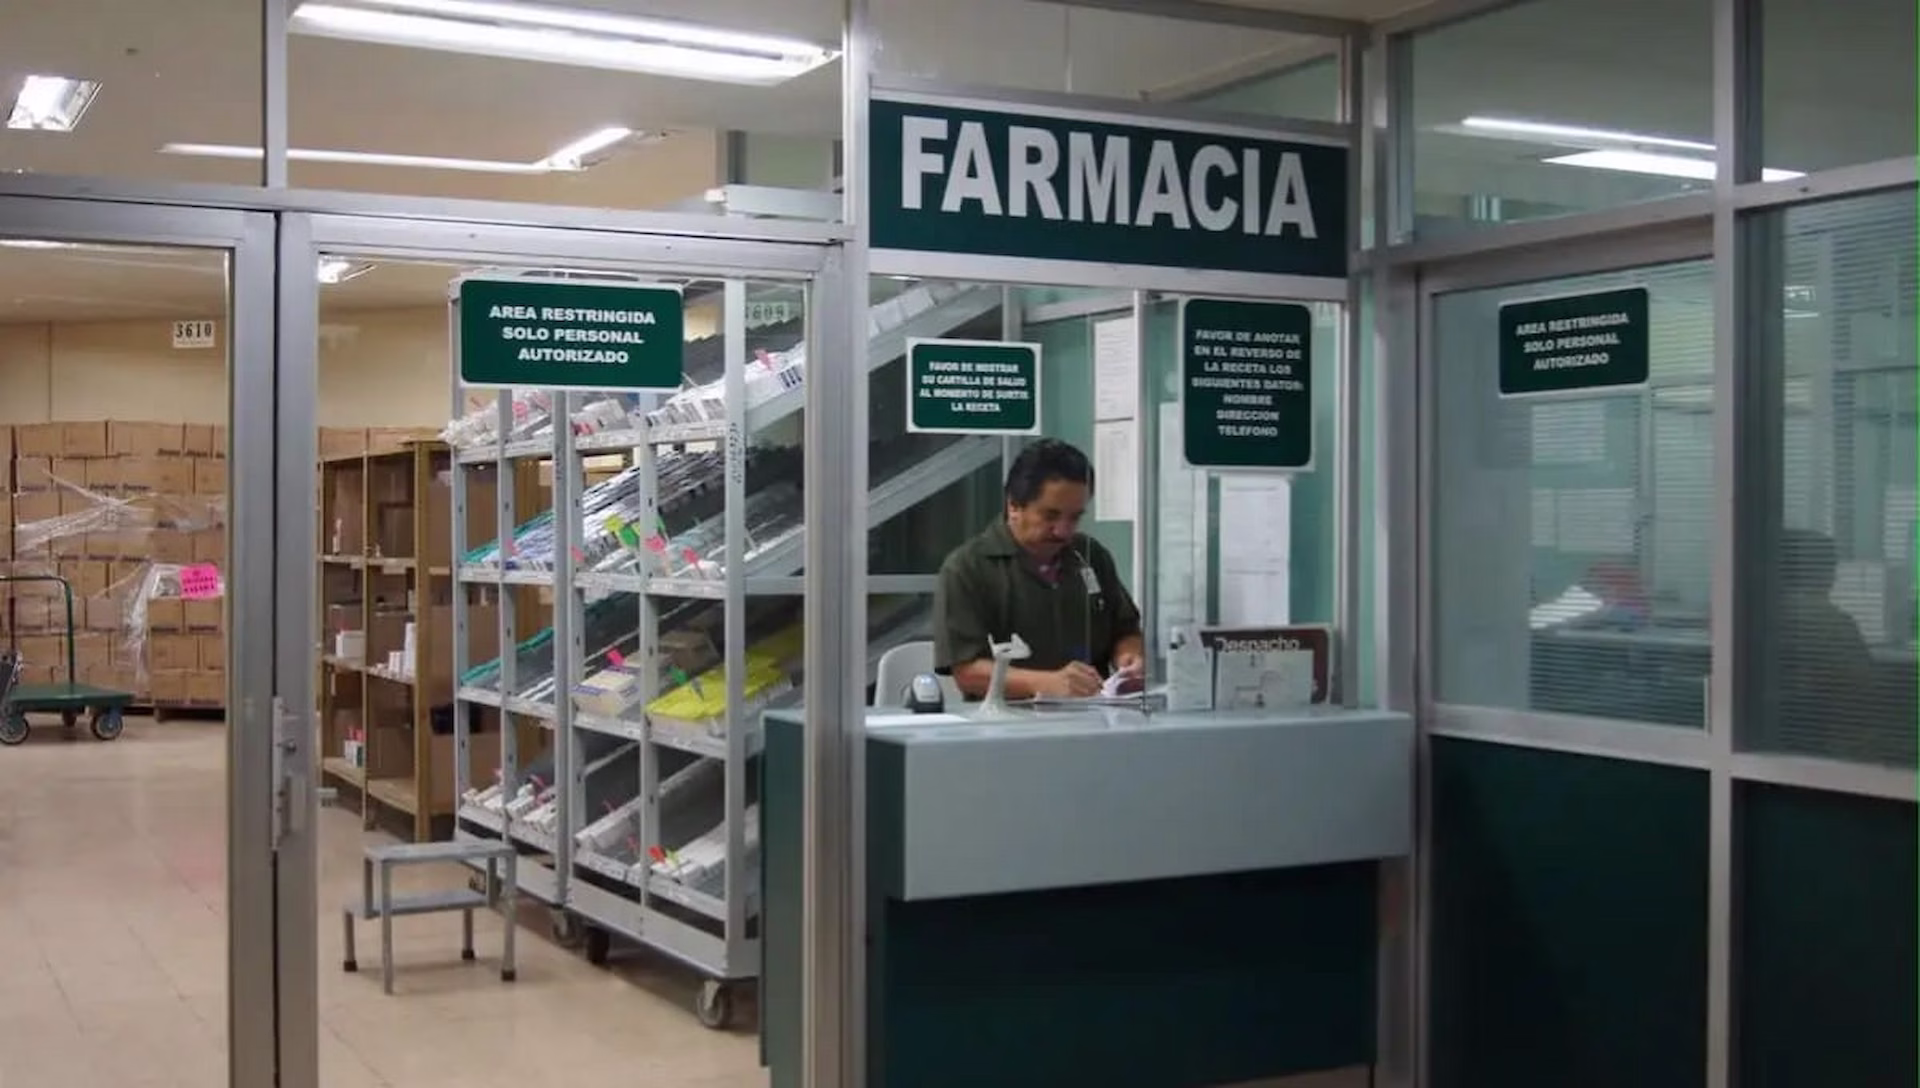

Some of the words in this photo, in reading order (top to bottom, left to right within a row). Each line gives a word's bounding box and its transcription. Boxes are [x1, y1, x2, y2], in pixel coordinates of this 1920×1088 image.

[902, 114, 1318, 239] FARMACIA
[489, 305, 537, 320] AREA
[541, 307, 656, 324] RESTRINGIDA
[175, 322, 212, 338] 3610
[1516, 322, 1547, 336] AREA
[1548, 312, 1629, 332] RESTRINGIDA
[502, 326, 550, 341] SOLO
[554, 328, 645, 344] PERSONAL
[1196, 329, 1233, 341] FAVOR
[1235, 331, 1251, 342] DE
[1253, 332, 1301, 344] ANOTAR
[1523, 339, 1555, 353] SOLO
[1556, 332, 1621, 349] PERSONAL
[517, 347, 630, 364] AUTORIZADO
[1194, 344, 1211, 356] EN
[1213, 345, 1228, 357] EL
[1229, 346, 1284, 359] REVERSO
[1285, 348, 1302, 360] DE
[929, 361, 959, 371] FAVOR
[1203, 360, 1220, 373] LA
[1221, 361, 1267, 374] RECETA
[1268, 363, 1292, 375] LOS
[1533, 351, 1610, 371] AUTORIZADO
[921, 374, 935, 385] SU
[936, 374, 981, 386] CARTILLA
[982, 375, 995, 386] DE
[997, 376, 1027, 387] SALUD
[1191, 377, 1261, 390] SIGUIENTES
[920, 388, 932, 398] AL
[981, 389, 994, 399] DE
[1223, 393, 1273, 406] NOMBRE
[950, 401, 964, 412] LA
[965, 402, 1001, 413] RECETA
[1216, 409, 1280, 421] DIRECCION
[1218, 424, 1278, 437] TELEFONO
[1215, 635, 1300, 656] Despacho
